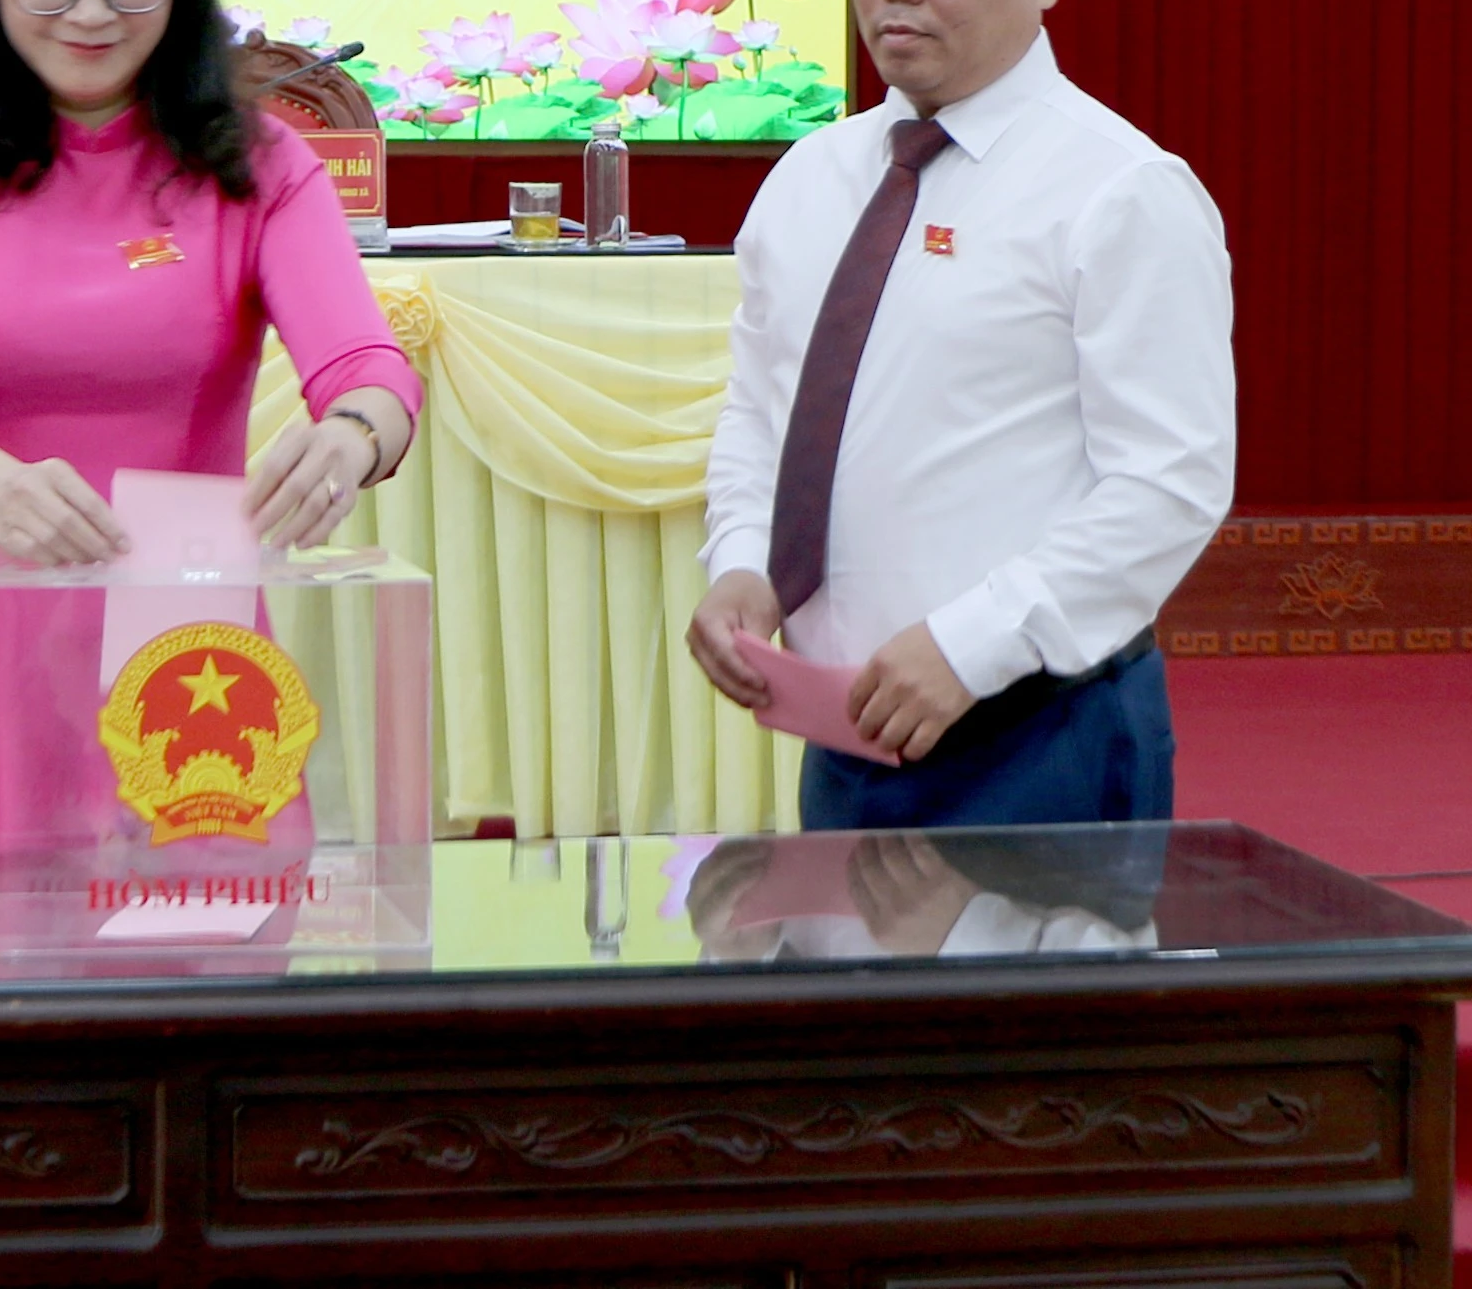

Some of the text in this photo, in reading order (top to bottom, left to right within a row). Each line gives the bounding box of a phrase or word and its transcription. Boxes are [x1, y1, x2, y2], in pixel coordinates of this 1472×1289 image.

[346, 150, 373, 177] HẢI
[87, 859, 331, 910] HÒM PHIẾU
